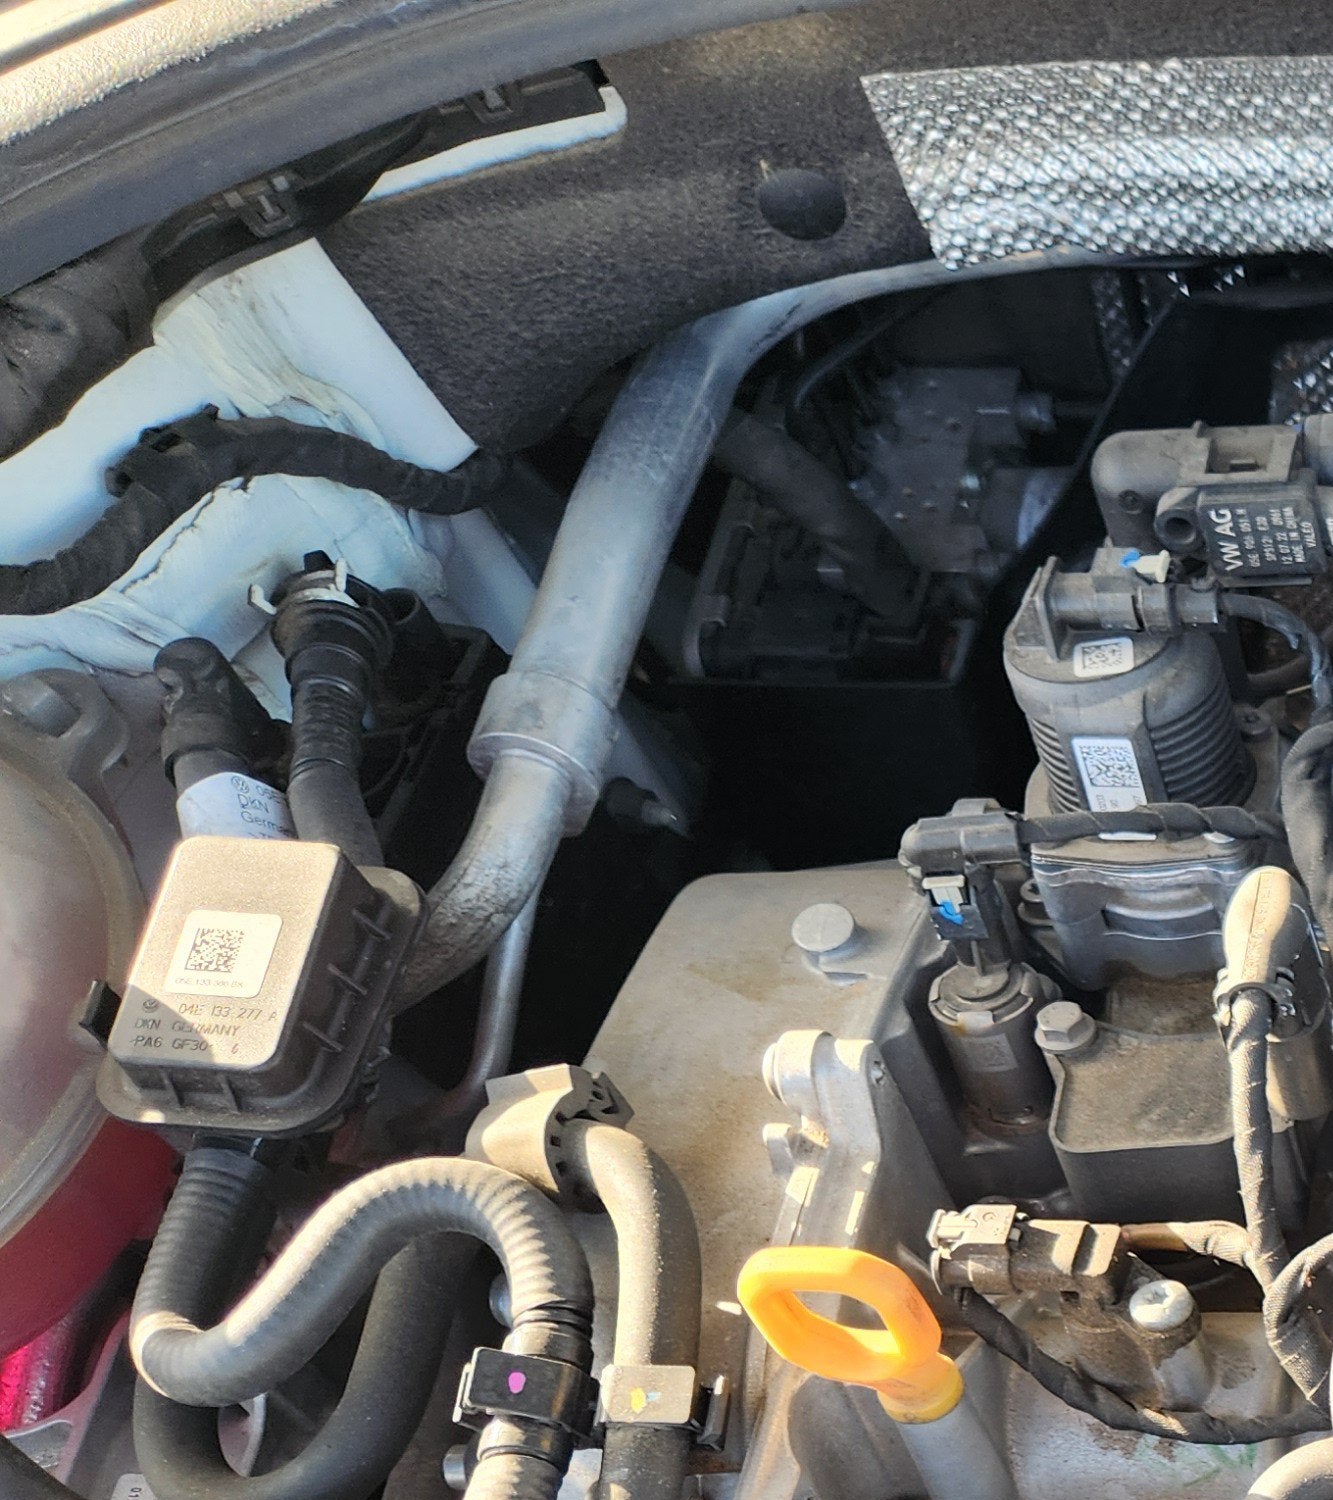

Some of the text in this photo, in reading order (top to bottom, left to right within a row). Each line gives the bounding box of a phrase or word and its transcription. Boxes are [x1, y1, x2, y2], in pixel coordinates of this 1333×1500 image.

[1209, 508, 1244, 572] VW AG
[1300, 521, 1317, 548] VALEO
[211, 1005, 231, 1018] 133
[172, 1021, 242, 1036] GERMANY
